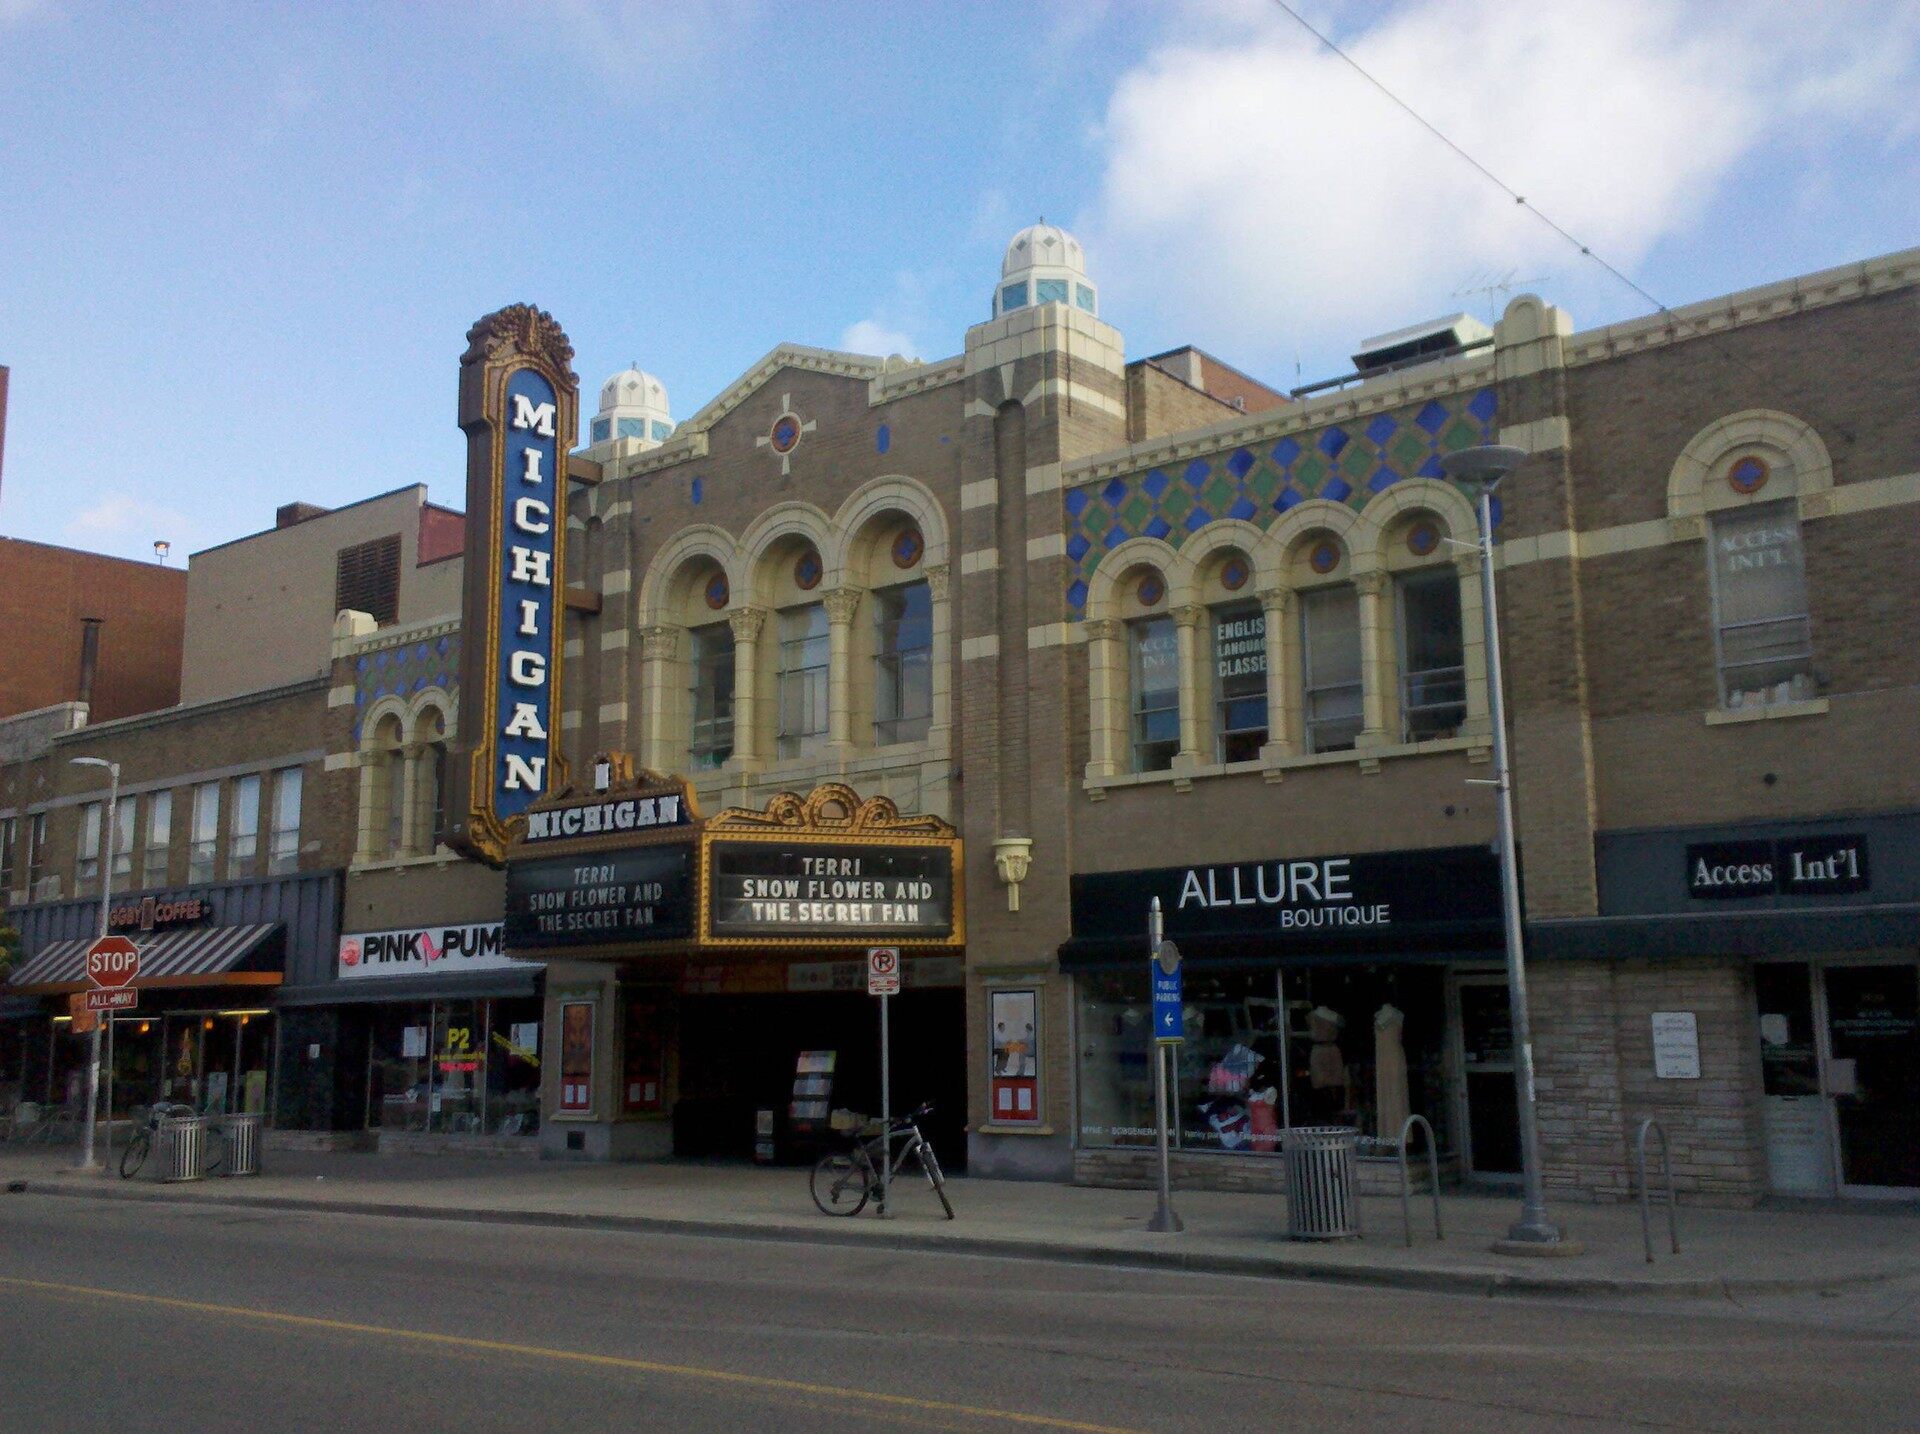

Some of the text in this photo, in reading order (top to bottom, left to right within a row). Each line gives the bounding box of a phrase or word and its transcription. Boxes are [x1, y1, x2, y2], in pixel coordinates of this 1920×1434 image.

[505, 393, 556, 791] MICHIGAN
[527, 795, 680, 839] MICHIGAN
[574, 864, 616, 884] TERRI
[803, 857, 861, 876] TERRI
[1694, 848, 1860, 886] Access Int'l
[743, 879, 932, 899] SNOW FLOWER AND
[1178, 859, 1353, 908] ALLURE
[530, 882, 662, 911] SNOW FLOWER AND
[155, 899, 201, 922] COFFEE
[538, 906, 654, 932] THE SECRET FAN
[752, 902, 919, 922] THE SECRET FAN
[1281, 904, 1391, 928] BOUTIQUE
[363, 926, 506, 964] PINK PUM
[91, 951, 136, 973] STOP
